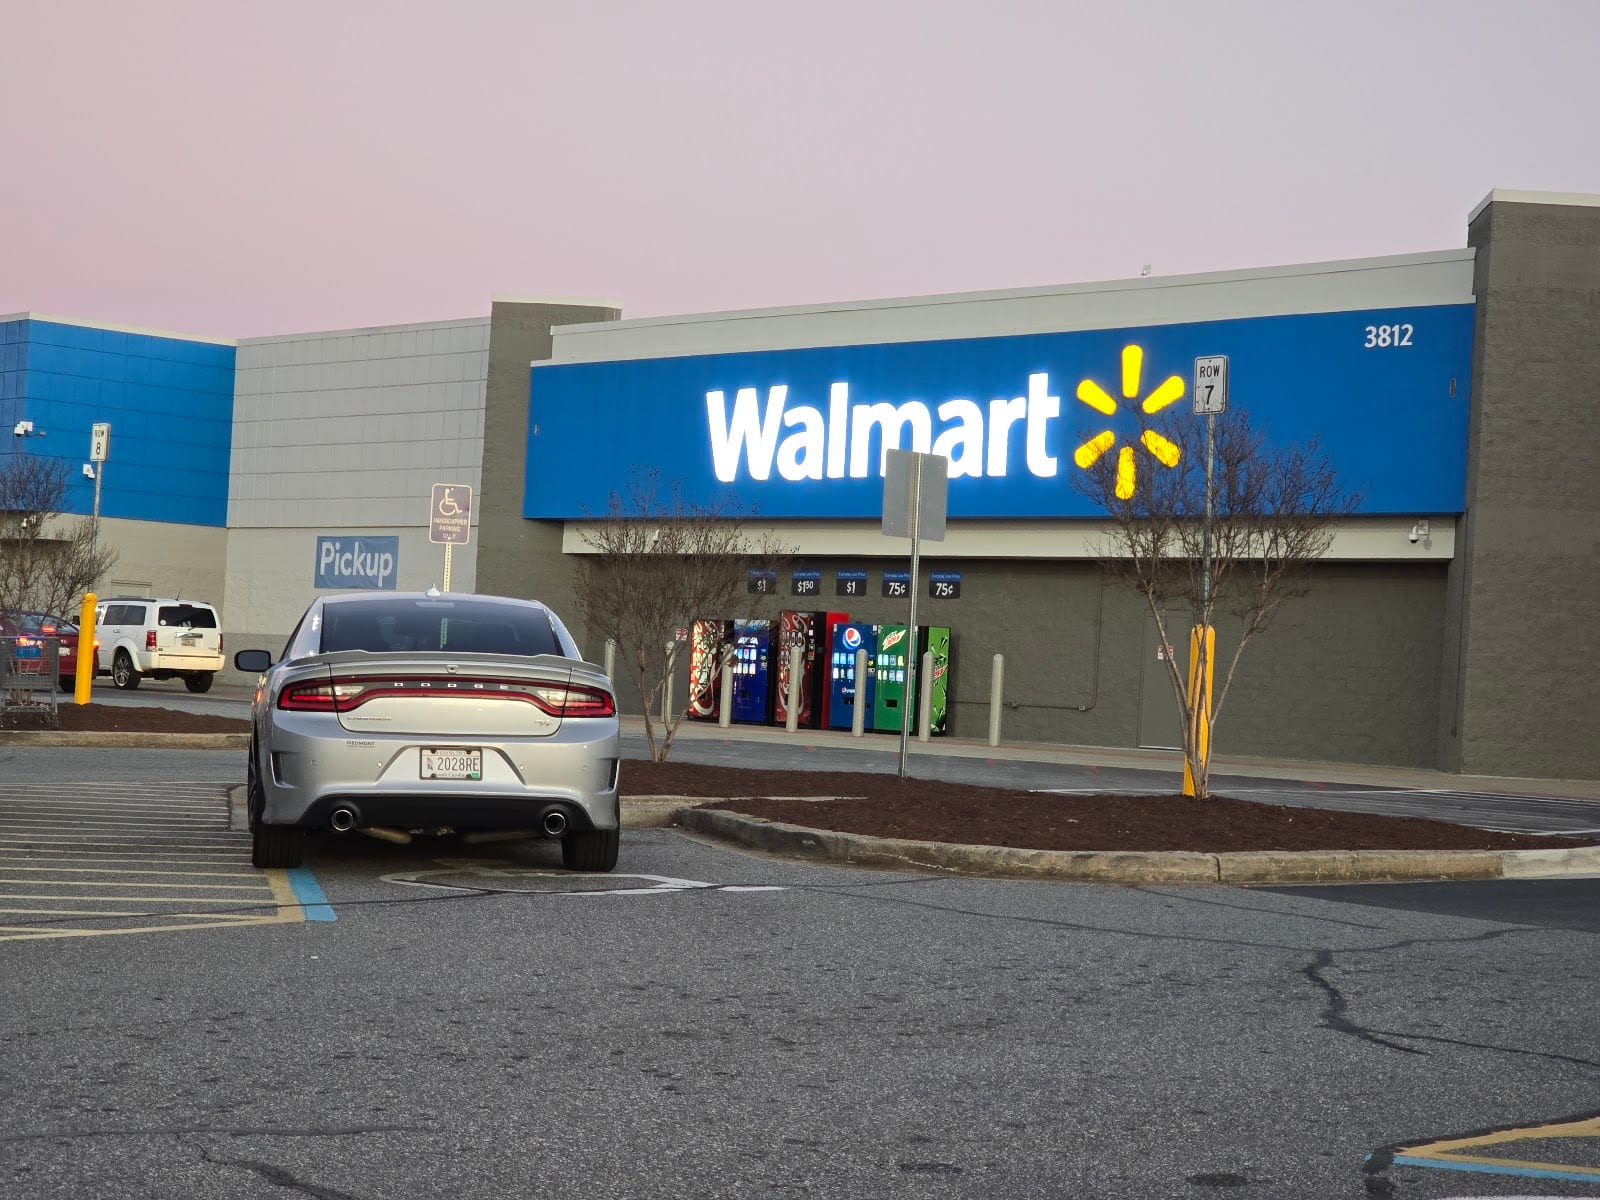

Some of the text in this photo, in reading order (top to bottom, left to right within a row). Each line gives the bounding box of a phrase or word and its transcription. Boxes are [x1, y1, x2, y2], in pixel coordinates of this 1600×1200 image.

[1364, 323, 1414, 348] 3812
[1199, 365, 1220, 378] ROW
[1204, 384, 1215, 406] 7
[705, 373, 1061, 483] Walmart
[96, 442, 101, 455] 8
[320, 541, 393, 588] Pickup
[846, 581, 856, 594] $1
[888, 582, 906, 596] 75¢
[935, 582, 954, 596] 75¢
[437, 757, 480, 771] 2028RE
